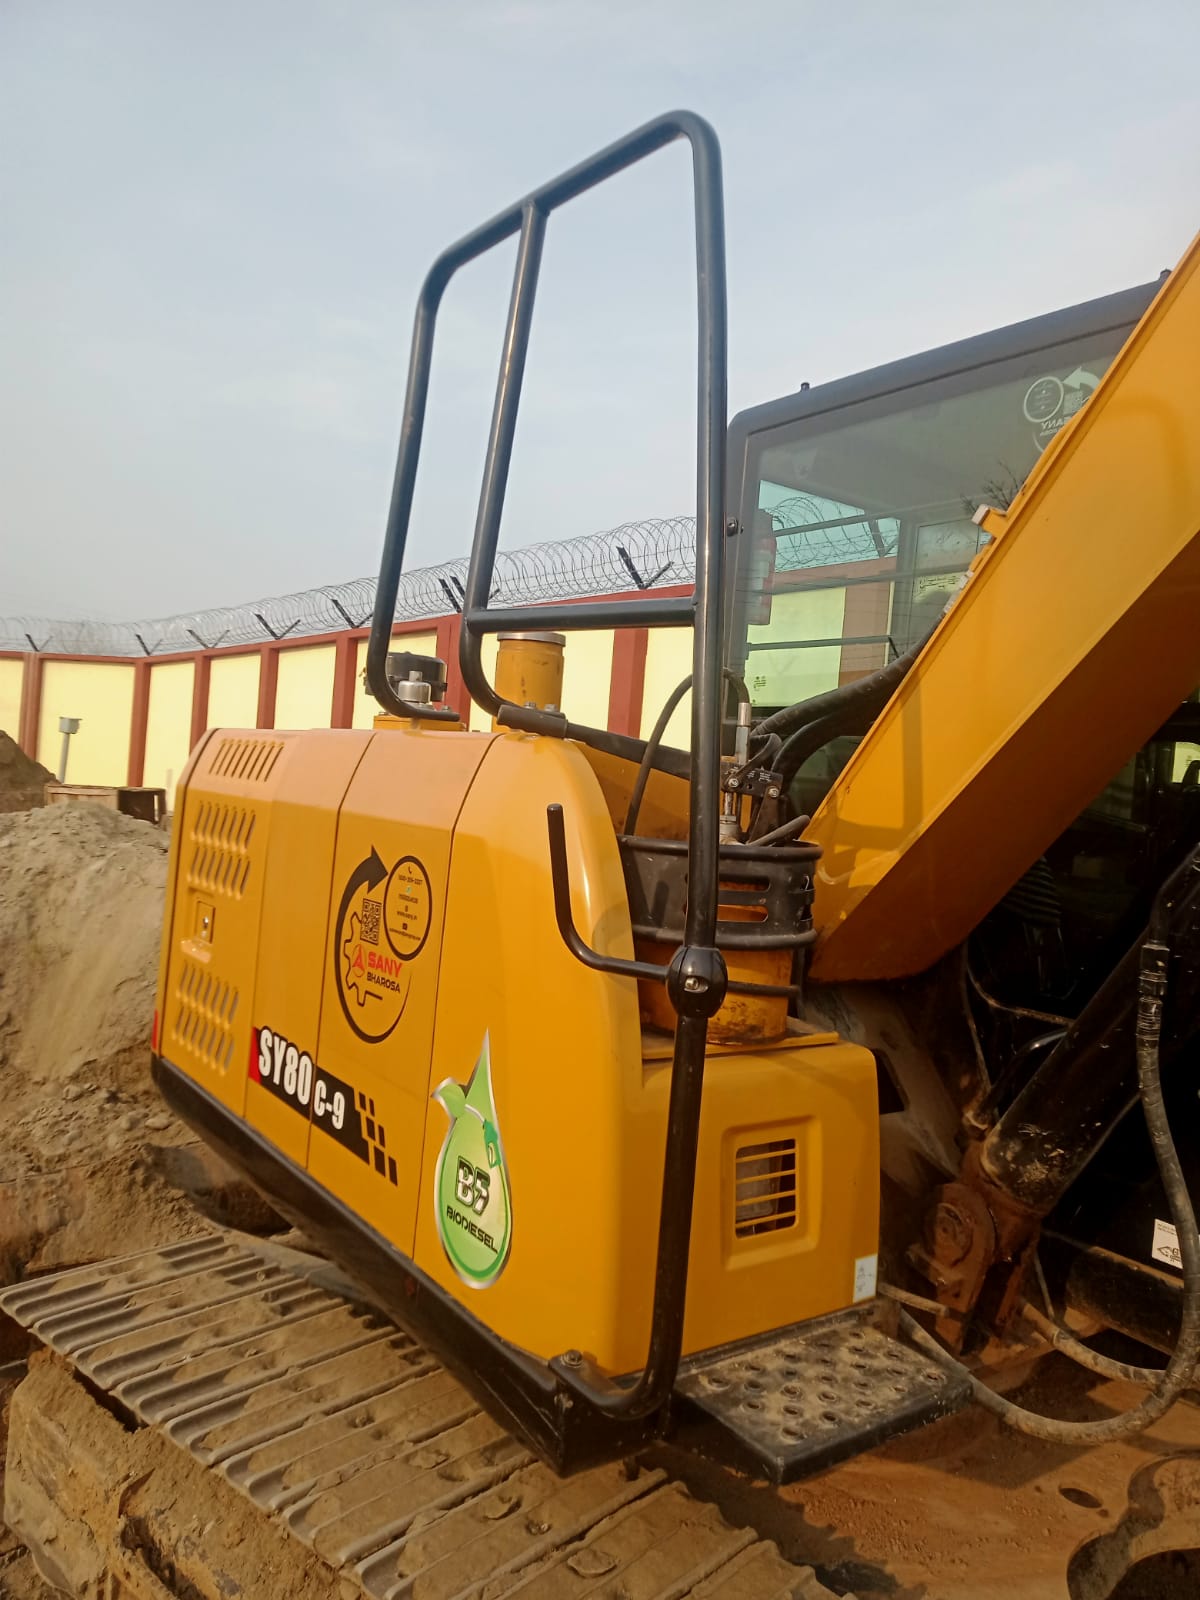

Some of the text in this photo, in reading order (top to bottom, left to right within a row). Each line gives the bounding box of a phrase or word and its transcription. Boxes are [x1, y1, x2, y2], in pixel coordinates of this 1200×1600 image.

[366, 971, 401, 994] BHAROSA
[367, 951, 403, 978] SANY
[258, 1028, 346, 1130] SY80 C-9
[446, 1205, 499, 1254] BIODIESEL
